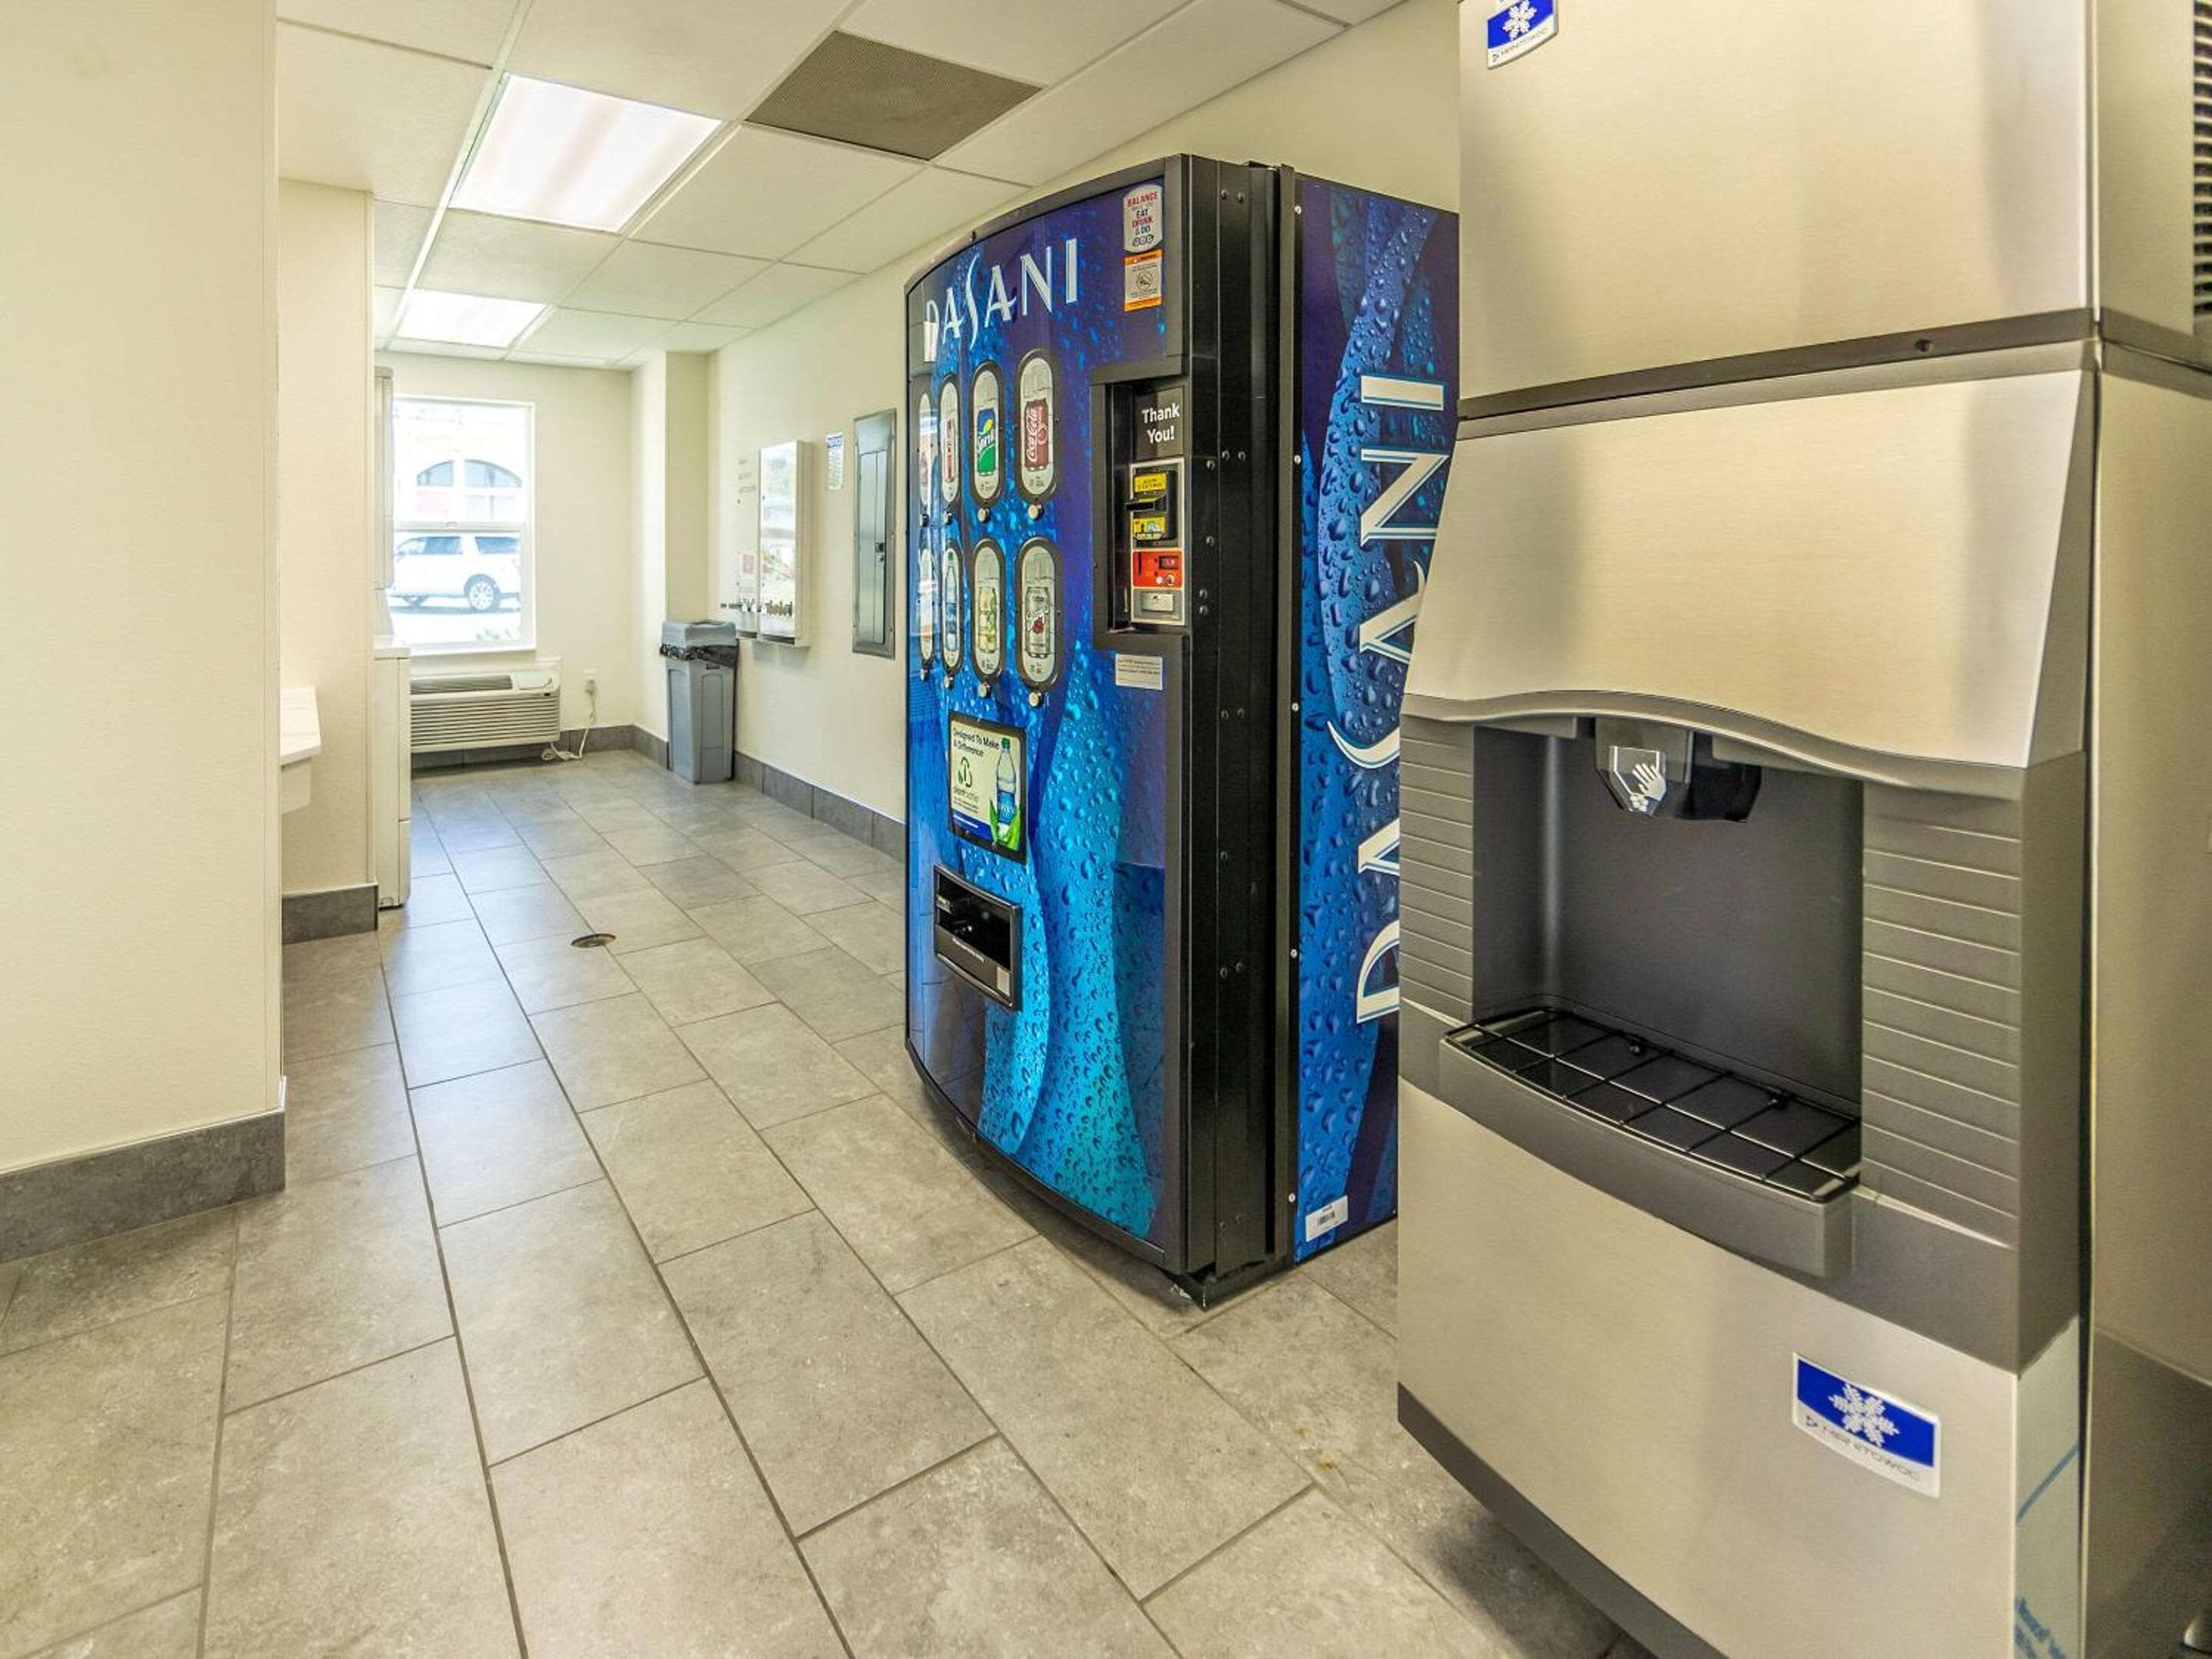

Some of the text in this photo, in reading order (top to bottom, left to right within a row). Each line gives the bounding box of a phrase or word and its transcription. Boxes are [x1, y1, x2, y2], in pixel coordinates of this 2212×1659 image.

[1127, 190, 1159, 207] BALANCE
[923, 237, 1078, 356] DASANI
[1141, 402, 1181, 424] Thank
[1147, 425, 1175, 444] You!
[983, 736, 1001, 750] Make
